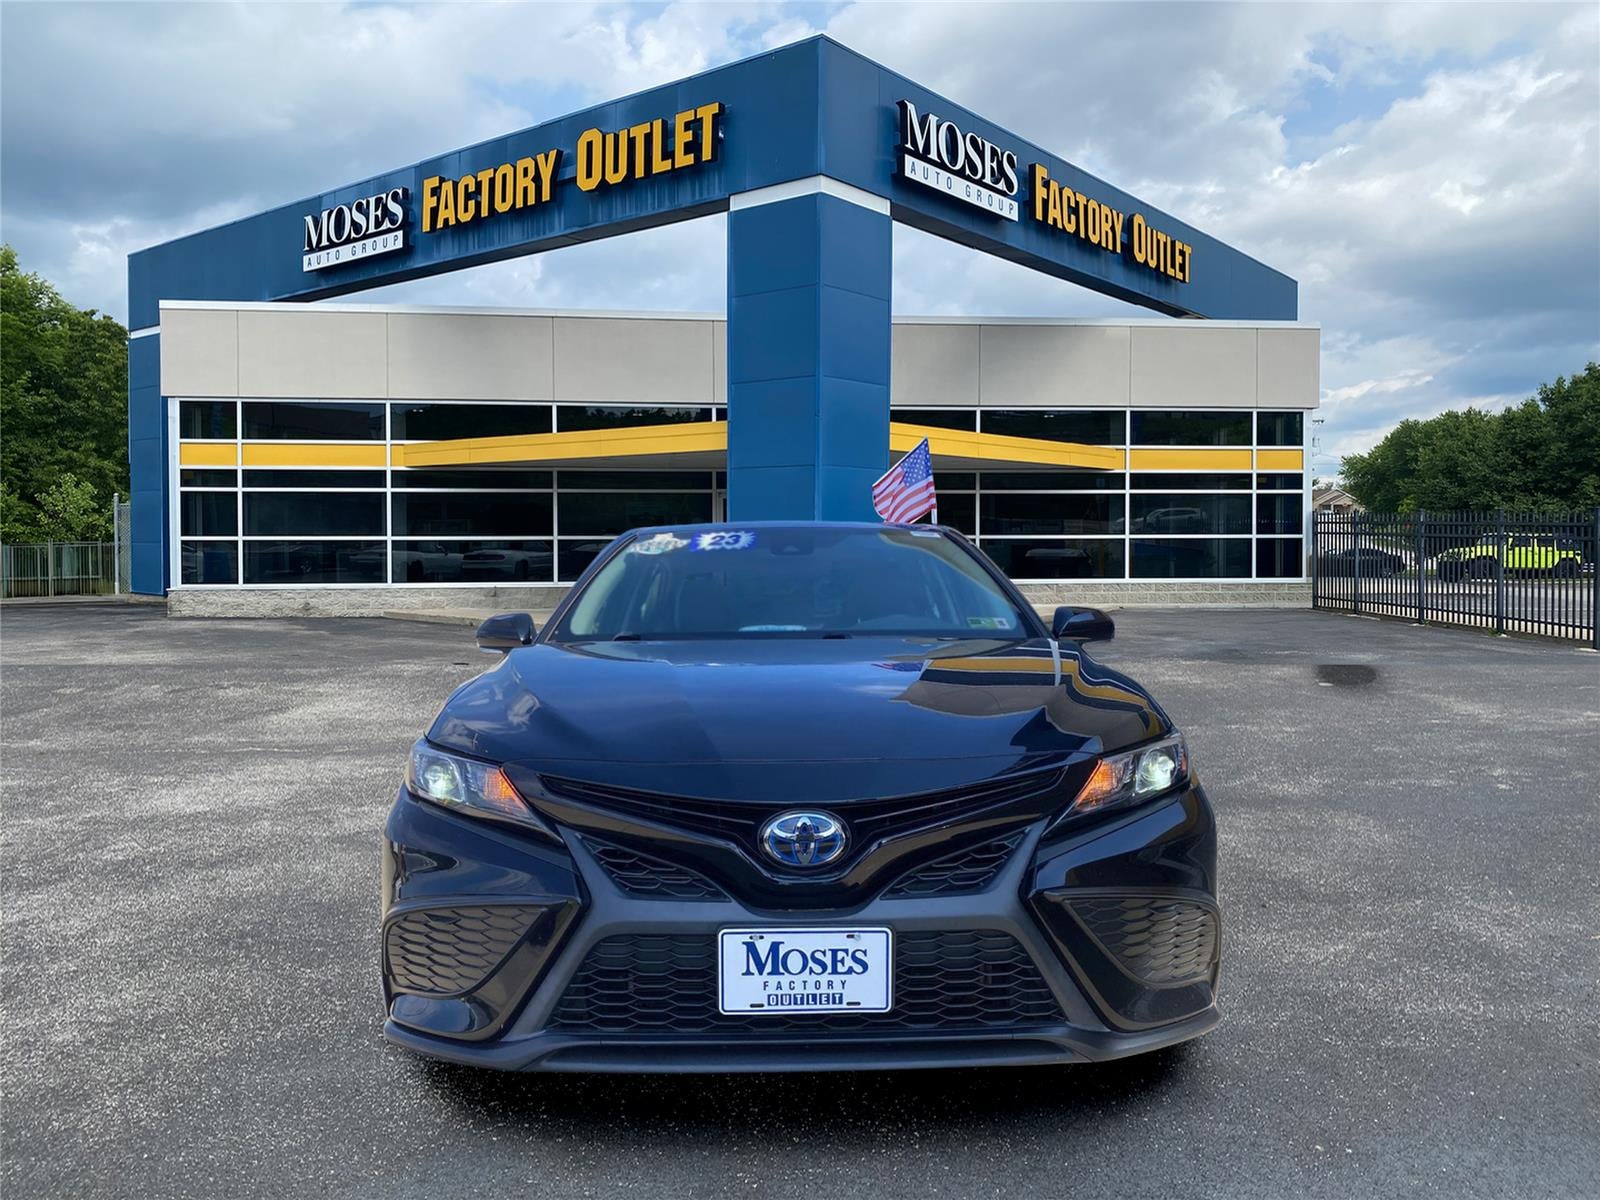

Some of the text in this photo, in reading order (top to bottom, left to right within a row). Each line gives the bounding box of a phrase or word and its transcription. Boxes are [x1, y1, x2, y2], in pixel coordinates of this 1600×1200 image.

[422, 102, 720, 232] FACTORY OUTLET
[905, 100, 1018, 196] MOSES
[910, 161, 1014, 214] AUTO GROUP
[303, 187, 403, 251] MOSES
[1034, 163, 1192, 283] FACTORY OUTLET
[307, 234, 399, 267] AUTO GROUP
[708, 534, 741, 546] 23
[741, 941, 869, 976] MOSES
[763, 979, 847, 991] FACTORY
[767, 993, 843, 1007] OUTLET
